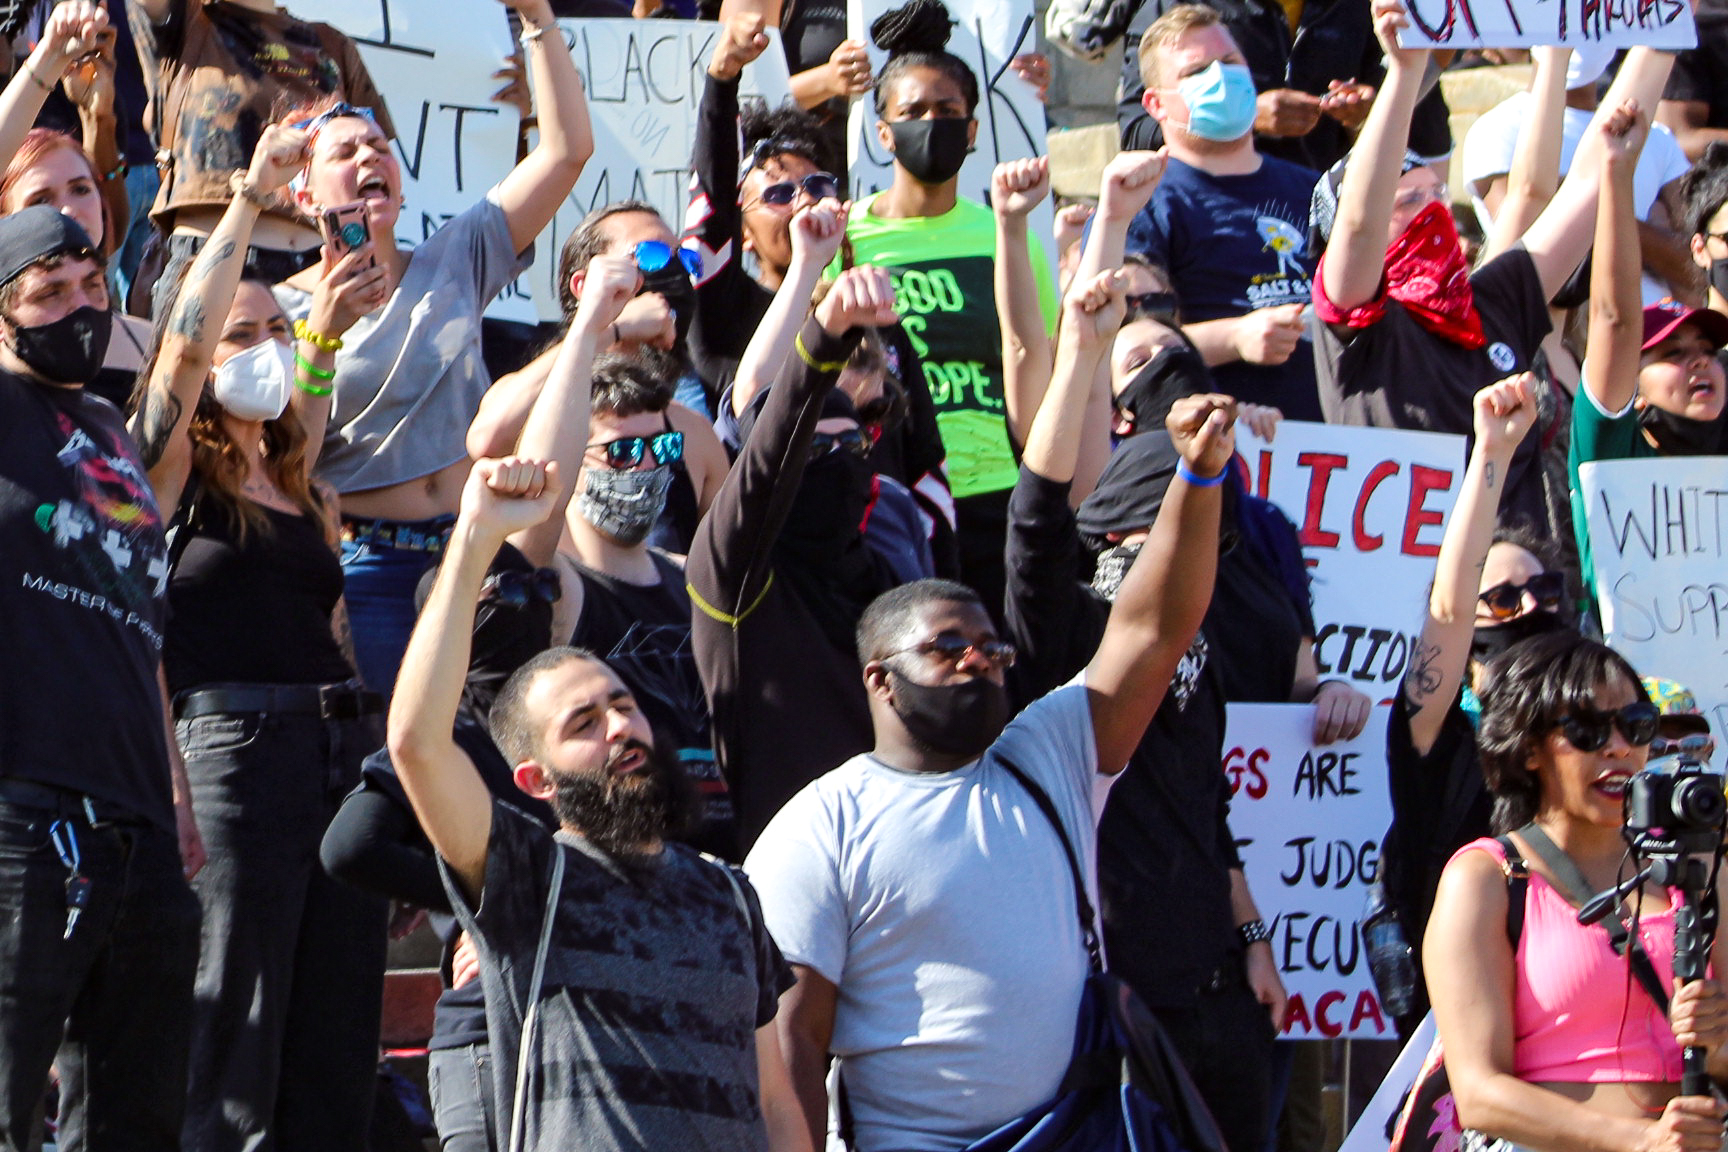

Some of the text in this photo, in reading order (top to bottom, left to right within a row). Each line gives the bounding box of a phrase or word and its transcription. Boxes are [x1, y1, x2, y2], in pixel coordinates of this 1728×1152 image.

[1600, 481, 1728, 562] WHIT
[22, 571, 107, 612] MASTER
[1613, 571, 1728, 643] SUPP
[1314, 623, 1419, 683] CTIO
[1294, 751, 1365, 801] ARE
[1280, 837, 1379, 890] JUDG
[1280, 990, 1399, 1039] ACA
